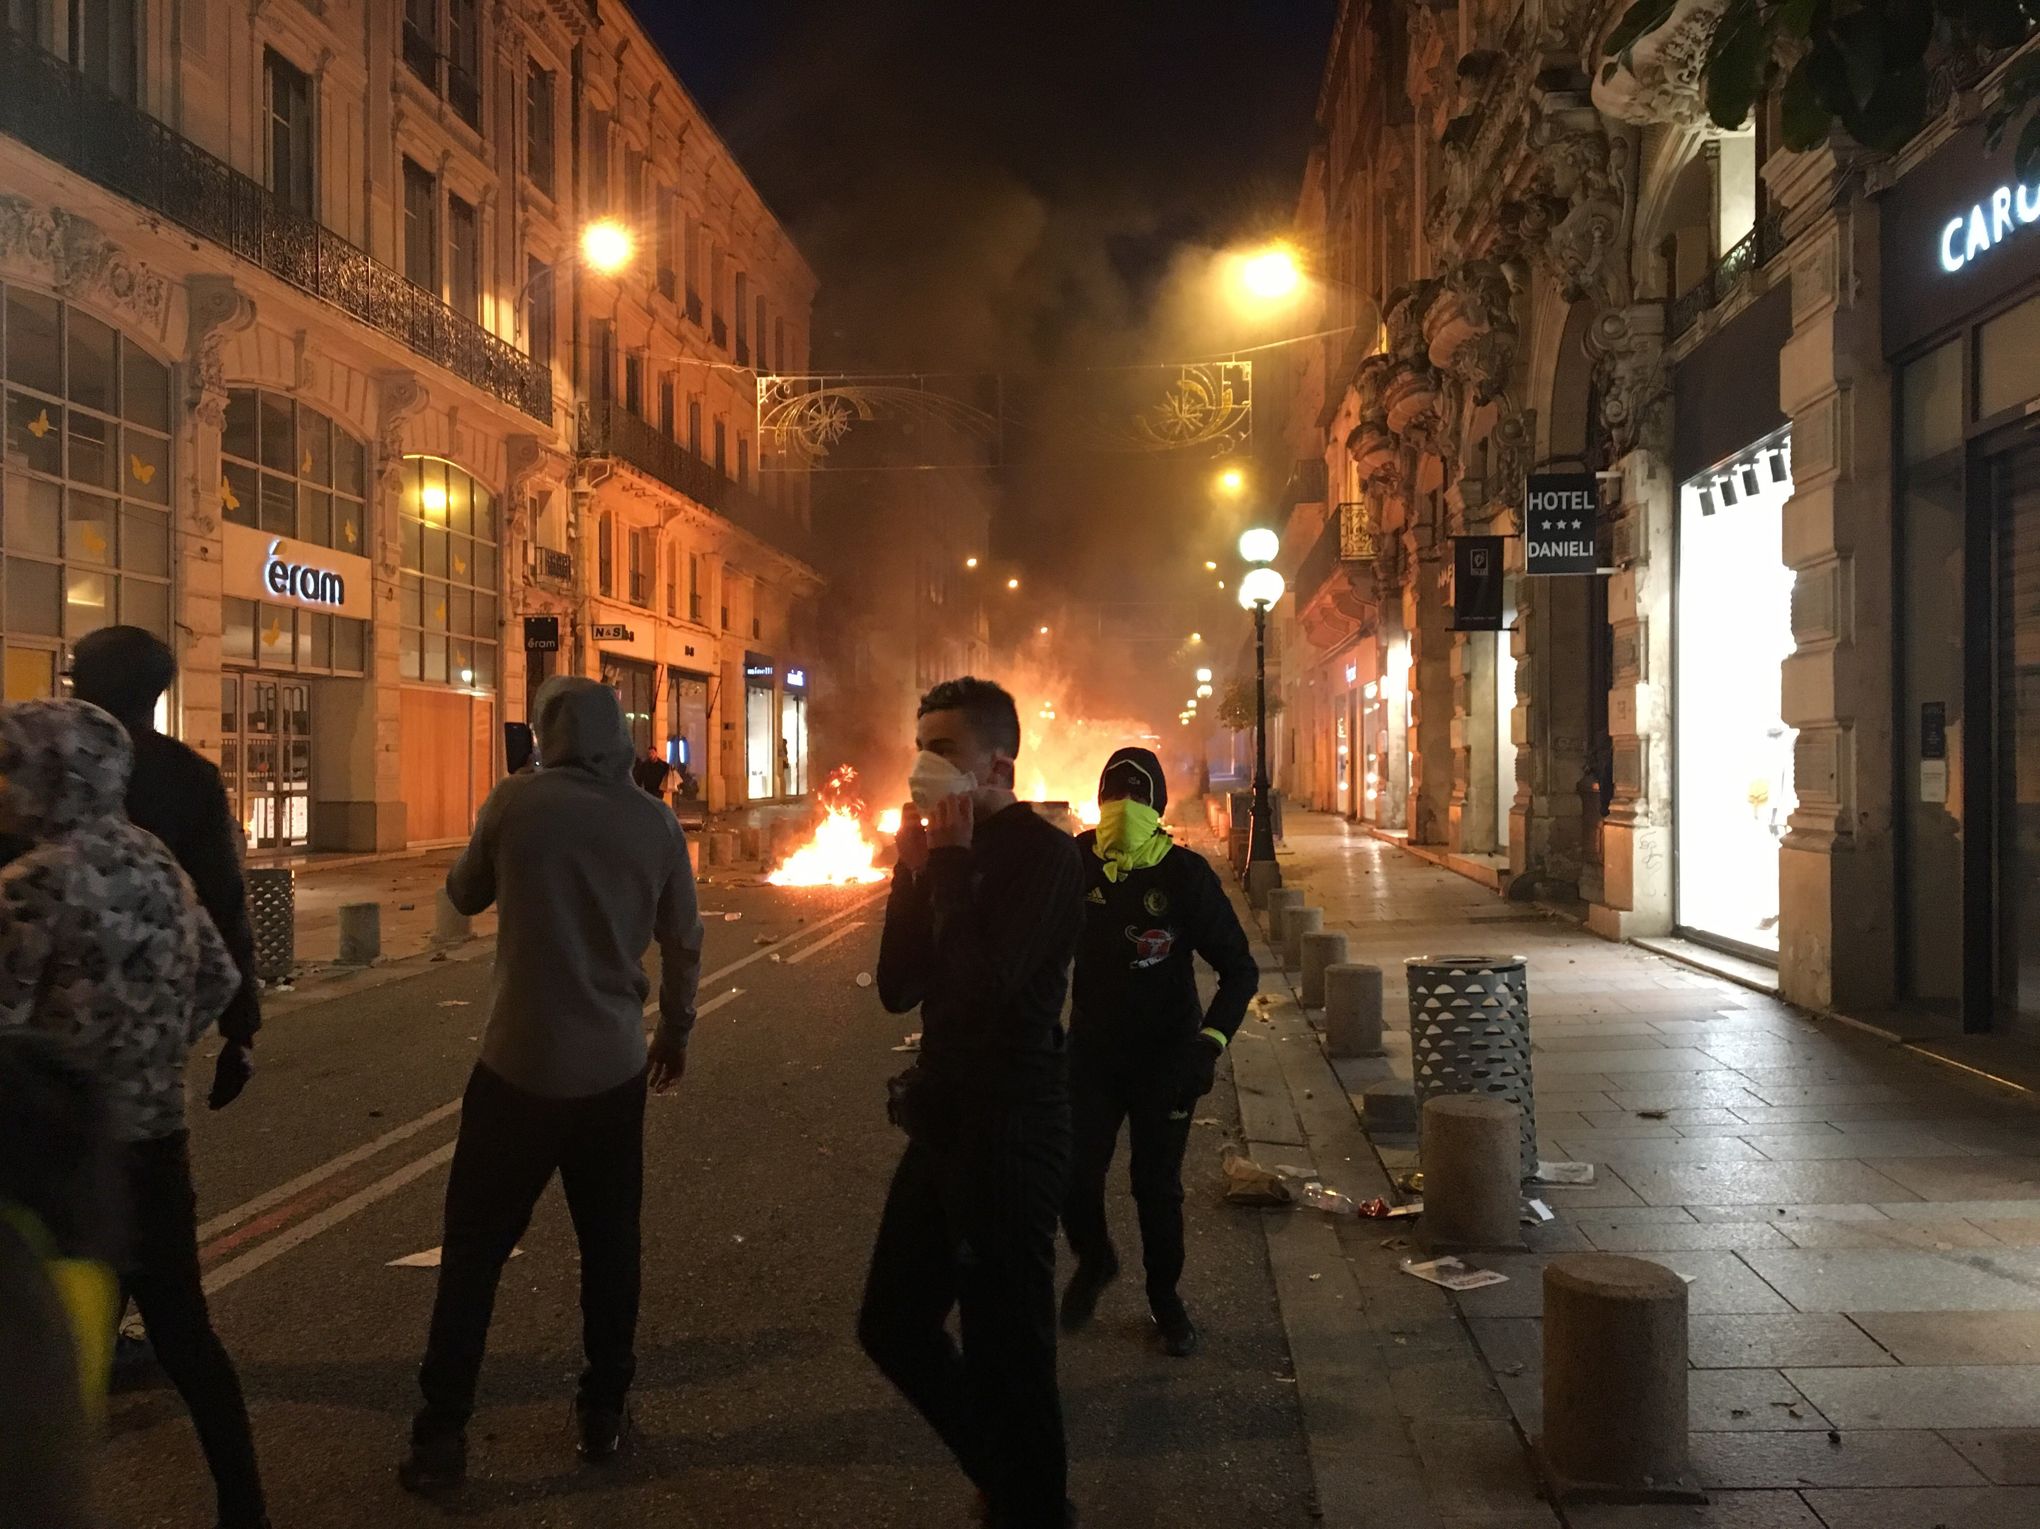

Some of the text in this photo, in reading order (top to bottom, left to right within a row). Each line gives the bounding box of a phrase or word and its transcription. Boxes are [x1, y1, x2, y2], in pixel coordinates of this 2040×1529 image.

[1529, 491, 1595, 511] HOTEL
[1528, 540, 1594, 558] DANIELI
[266, 539, 345, 605] éram
[528, 638, 556, 649] éram
